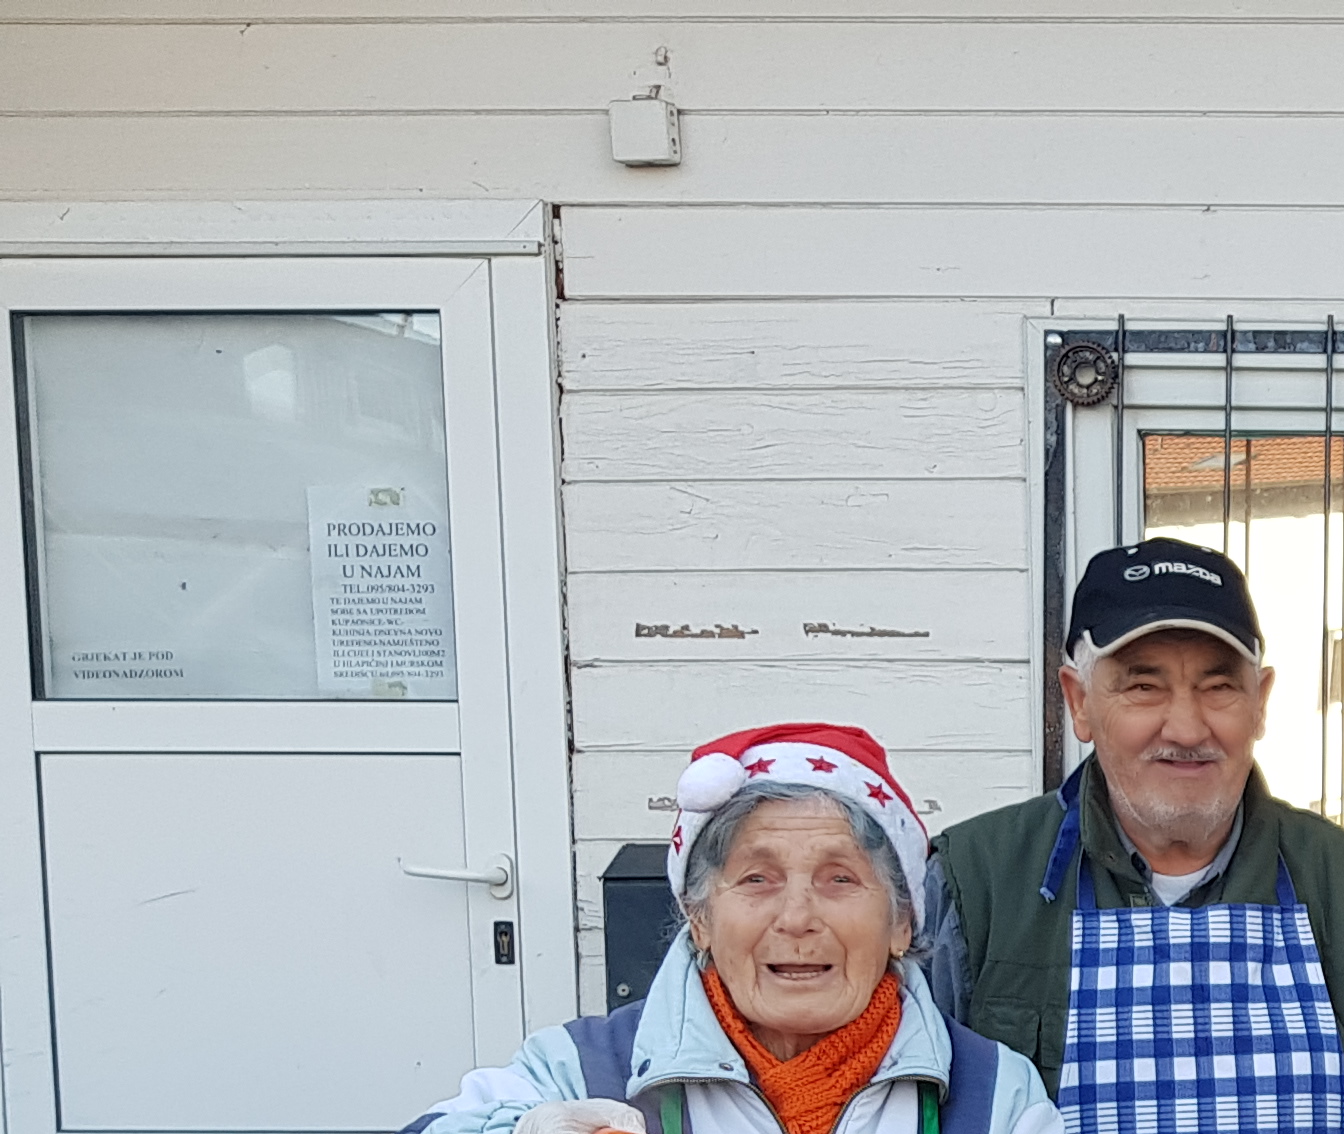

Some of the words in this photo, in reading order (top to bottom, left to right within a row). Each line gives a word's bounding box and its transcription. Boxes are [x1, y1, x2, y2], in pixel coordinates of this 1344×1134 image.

[326, 522, 436, 536] PRODAJEMO
[327, 543, 349, 558] ILI
[355, 543, 429, 558] DAJEMO
[342, 564, 355, 578] U
[360, 564, 421, 578] NAJAM
[390, 597, 423, 605] NAJAM
[414, 628, 443, 637] NOVO
[130, 651, 144, 661] JE
[148, 650, 174, 661] POD
[73, 668, 184, 679] VIDEONADZOROM
